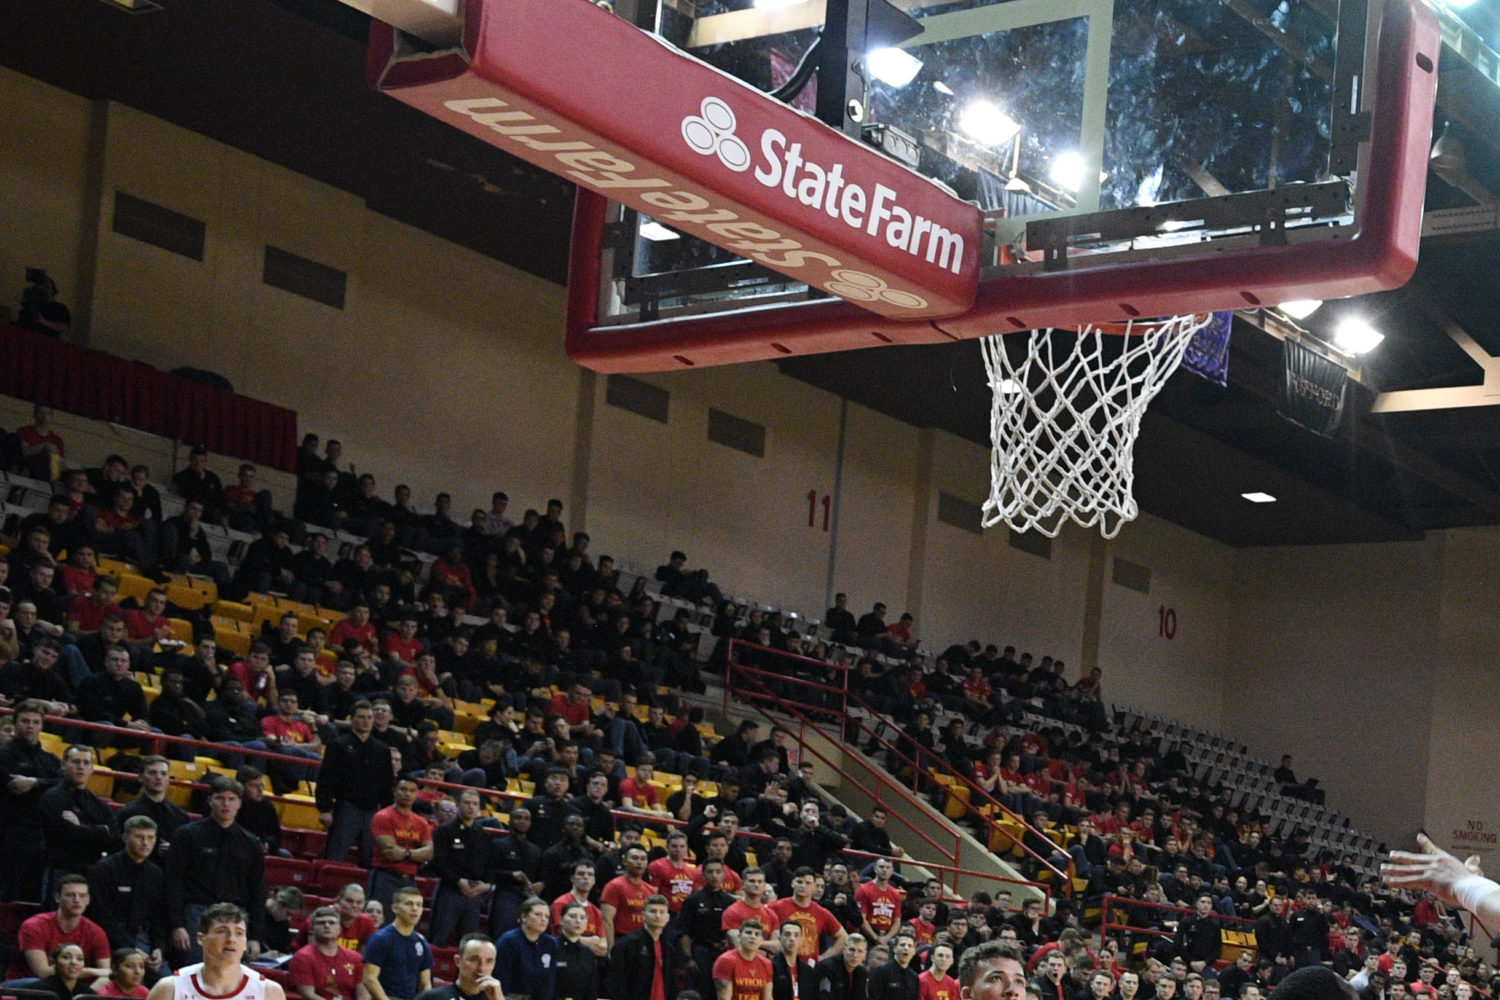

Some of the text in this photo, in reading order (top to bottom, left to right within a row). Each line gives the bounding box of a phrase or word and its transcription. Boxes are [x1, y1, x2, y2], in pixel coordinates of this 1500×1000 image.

[807, 489, 832, 532] 11
[1158, 605, 1177, 640] 10
[1453, 830, 1496, 843] SMOKING
[1468, 820, 1483, 831] NO
